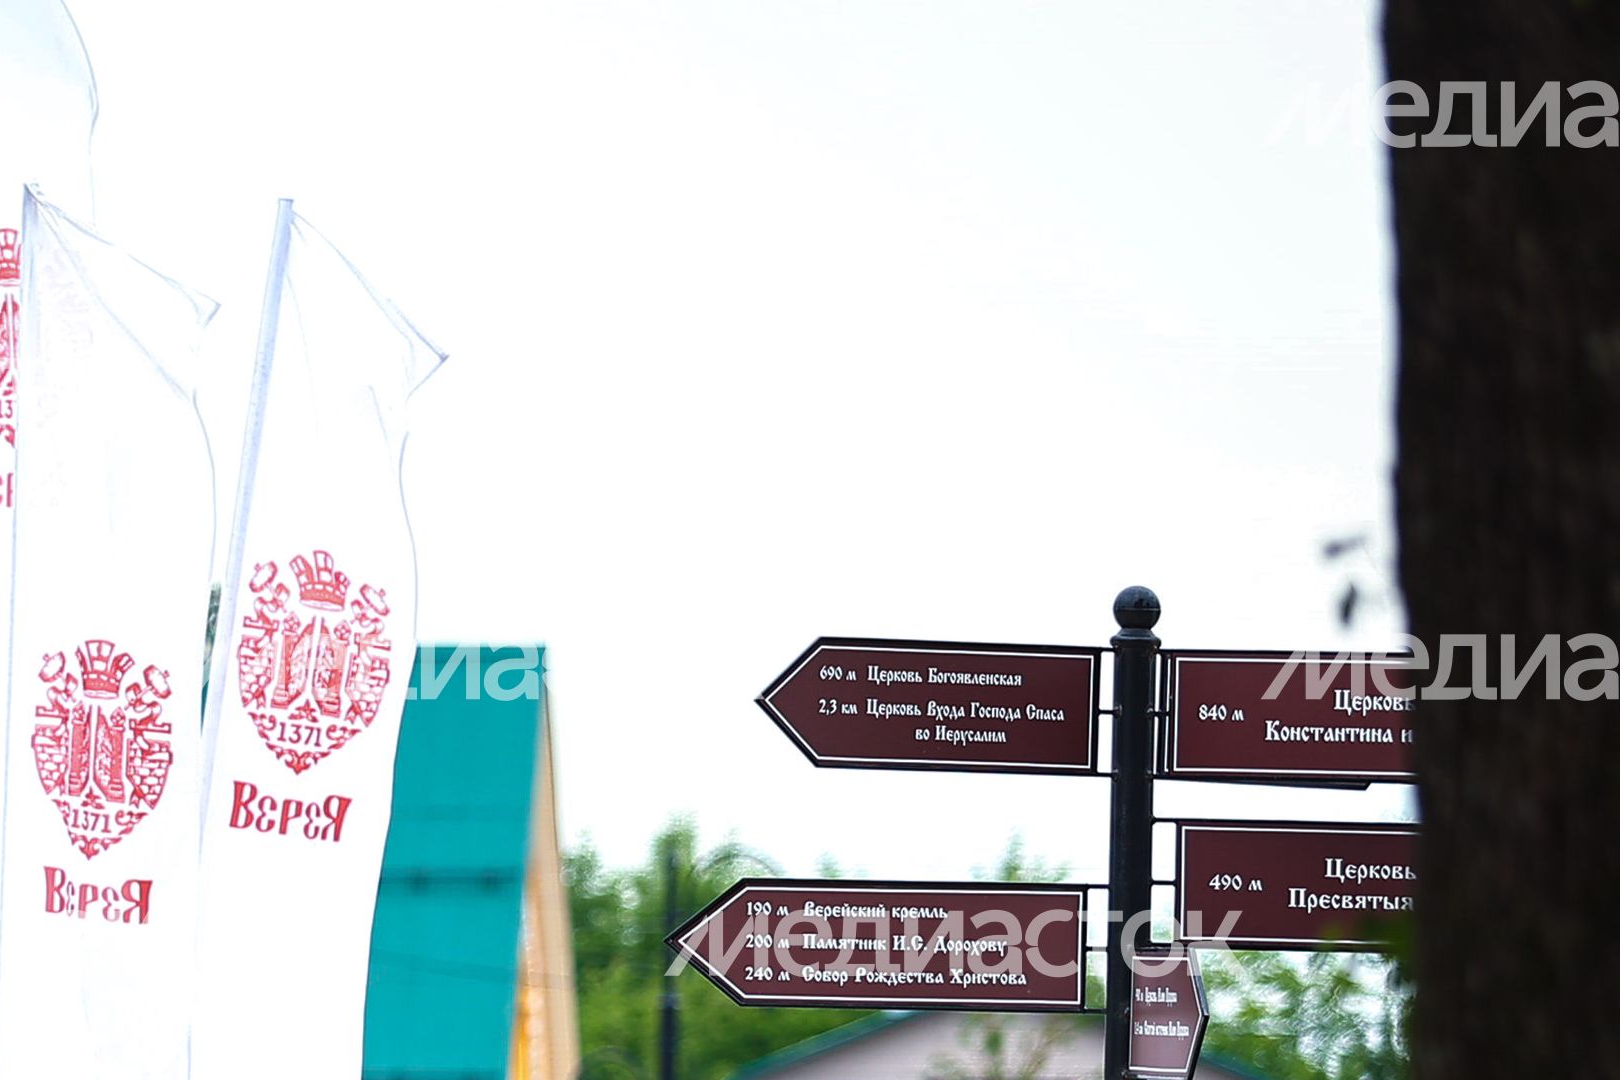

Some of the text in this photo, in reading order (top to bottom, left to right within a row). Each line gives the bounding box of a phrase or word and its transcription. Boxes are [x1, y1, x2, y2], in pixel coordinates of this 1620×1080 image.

[820, 665, 1023, 687] 690 м Церковь Богоявленская
[818, 699, 1065, 723] 2,3 км Церковь Входа Господа Спаса
[1198, 704, 1244, 722] 840 м
[276, 721, 323, 748] 1371
[915, 725, 1007, 746] во Иерусалим
[1264, 720, 1394, 744] Константина
[70, 808, 113, 833] 1371
[1208, 874, 1263, 892] 490 м
[1324, 858, 1417, 885] Церковь
[746, 901, 948, 922] 190 м Верейский кремль
[1288, 888, 1415, 914] Пресвятыя
[746, 934, 1008, 957] 200 м Памятник И.С. Дорохову
[745, 966, 1027, 989] 240 м Собор Рождества Христова
